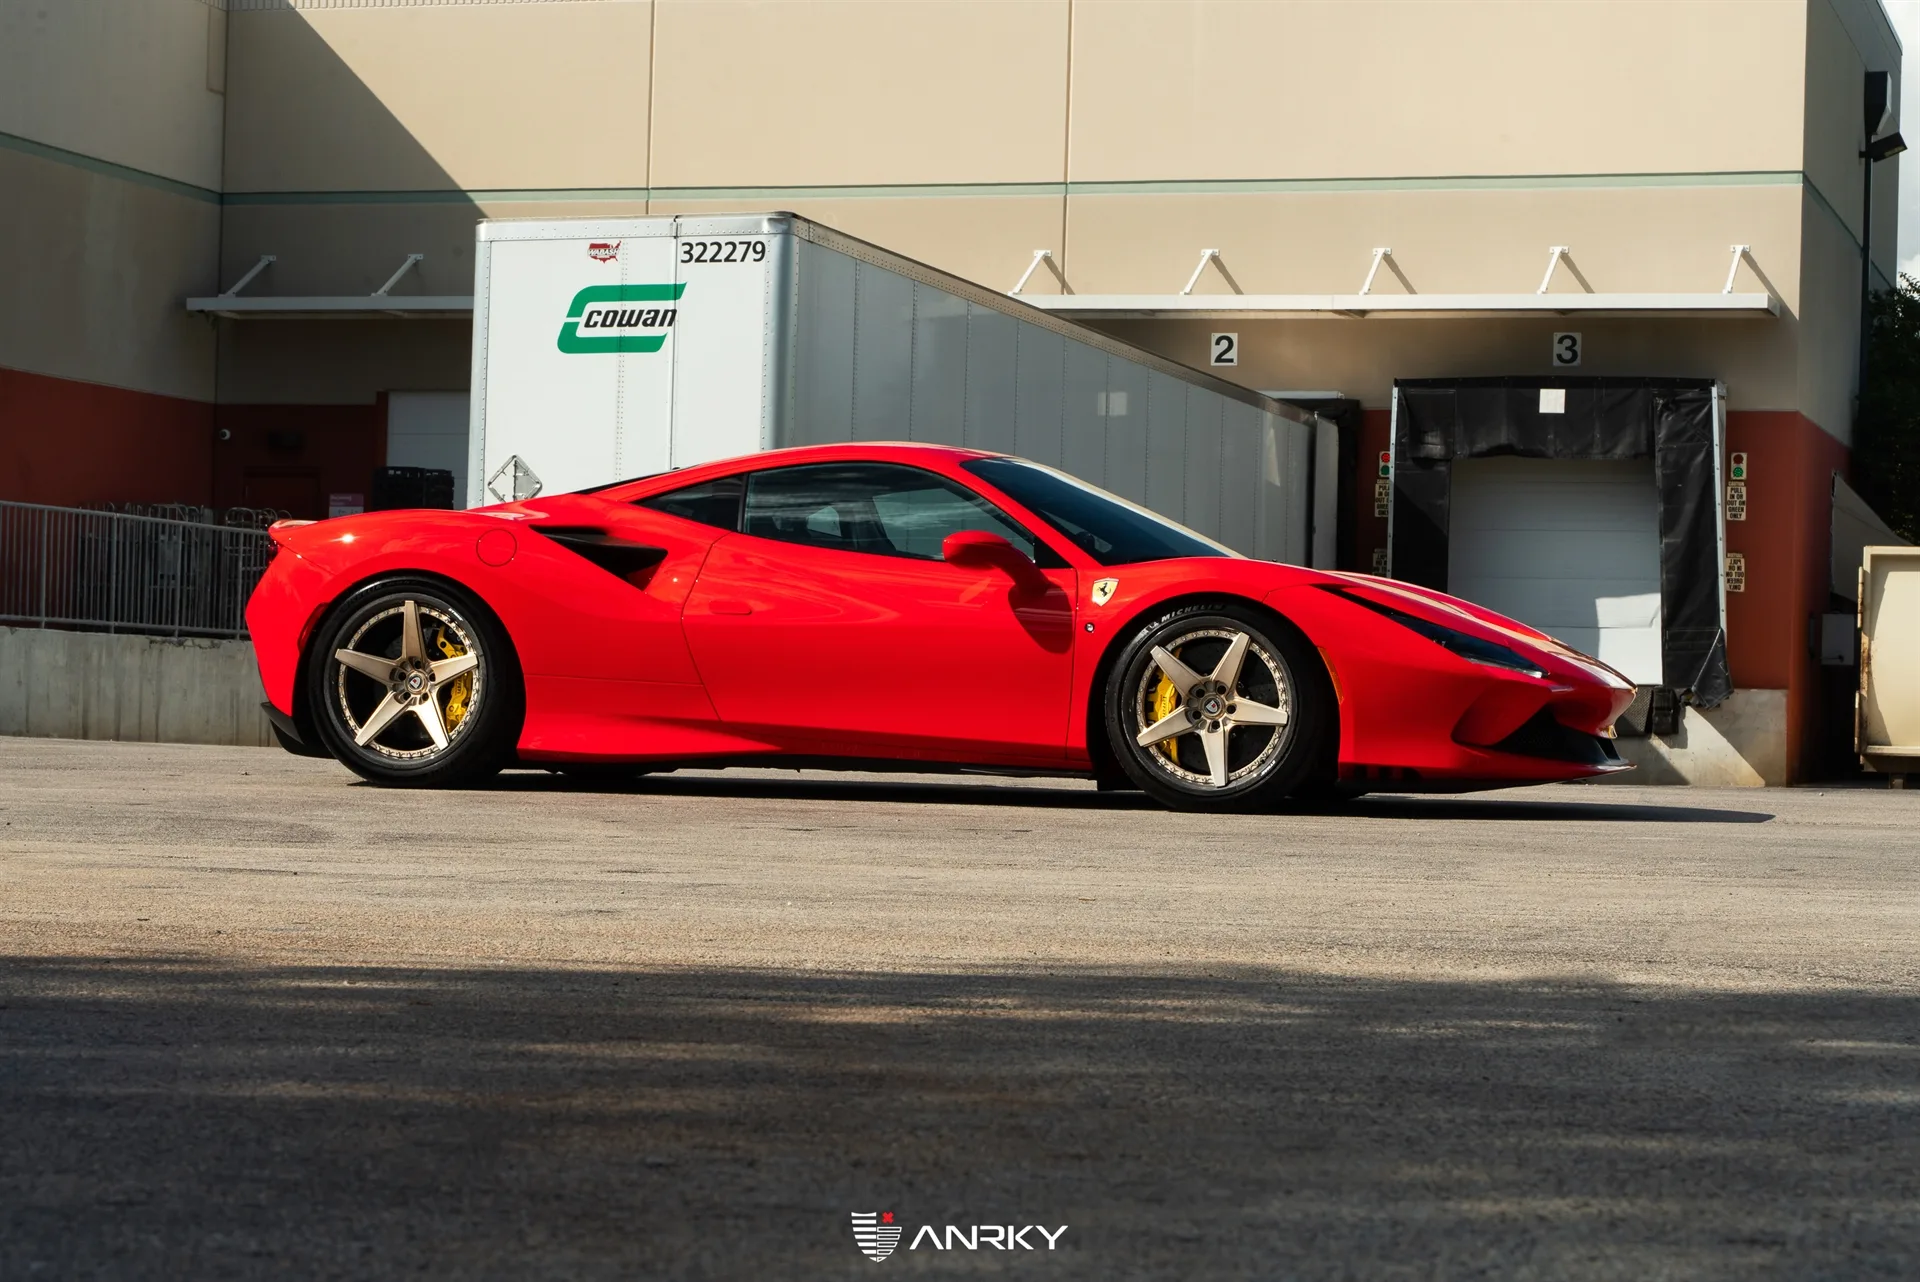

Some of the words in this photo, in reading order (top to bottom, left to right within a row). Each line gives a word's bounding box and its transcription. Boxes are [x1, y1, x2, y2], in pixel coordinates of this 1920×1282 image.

[680, 240, 766, 263] 322279
[1214, 335, 1234, 363] 2
[1556, 334, 1578, 364] 3
[1161, 604, 1223, 622] MICHELIN
